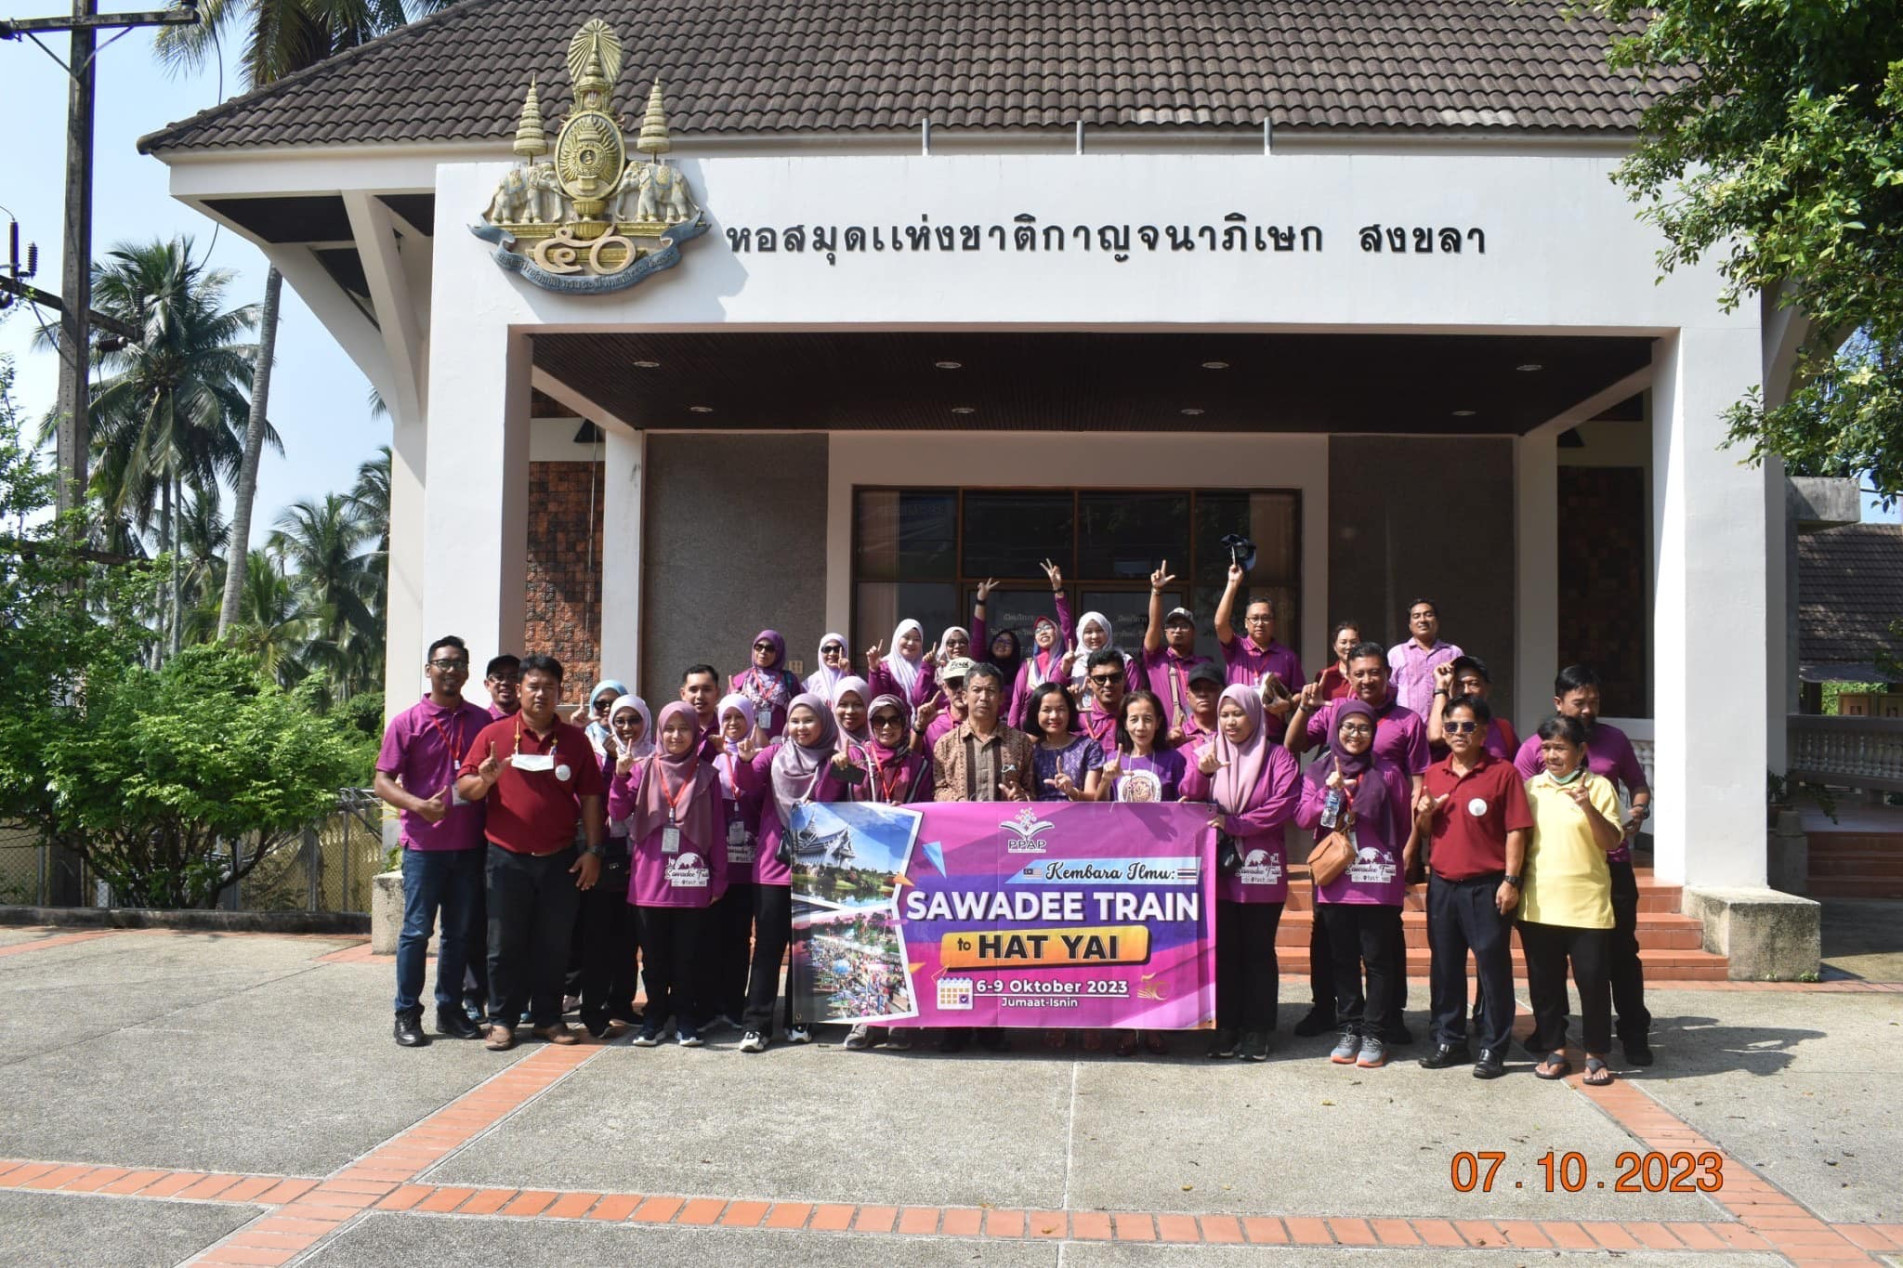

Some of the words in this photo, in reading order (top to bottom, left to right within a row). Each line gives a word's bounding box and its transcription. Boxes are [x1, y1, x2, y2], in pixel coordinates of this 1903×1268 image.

[725, 212, 1323, 266] หอสมุดแห่งชาติกาญจนาภิเษก
[1359, 224, 1486, 254] สงขลา
[1008, 839, 1047, 850] PPAP
[1045, 862, 1122, 881] Kembara
[906, 891, 1084, 922] SAWADEE
[1093, 892, 1199, 922] TRAIN
[957, 937, 972, 952] to
[978, 934, 1049, 960] HAT
[1061, 934, 1118, 960] YAI
[975, 979, 1004, 994] 6-9
[1009, 979, 1082, 994] Oktober
[1087, 979, 1129, 994] 2023
[1001, 997, 1078, 1009] Jumaat-Isnin
